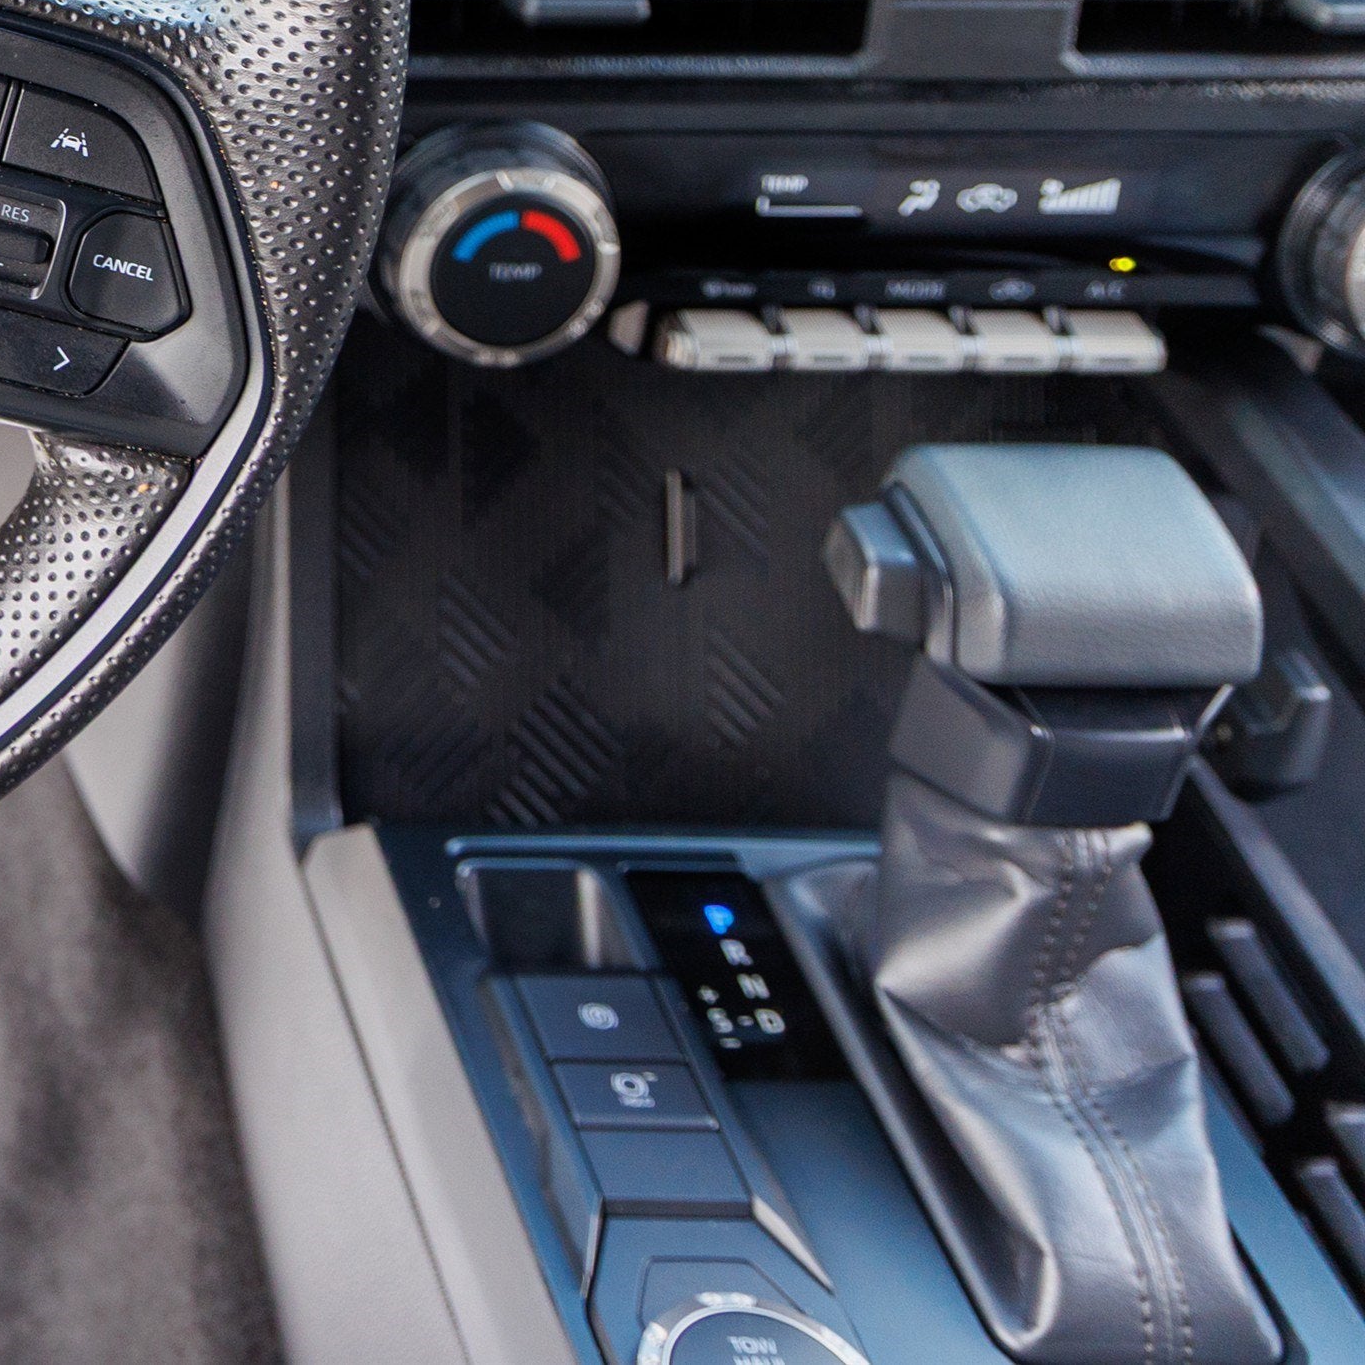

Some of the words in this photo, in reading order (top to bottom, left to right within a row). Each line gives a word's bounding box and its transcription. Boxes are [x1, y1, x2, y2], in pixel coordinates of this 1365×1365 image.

[92, 253, 154, 282] CANCEL
[719, 938, 754, 966] R
[736, 973, 771, 1000] N
[753, 1007, 787, 1035] D
[728, 1335, 779, 1355] TOW
